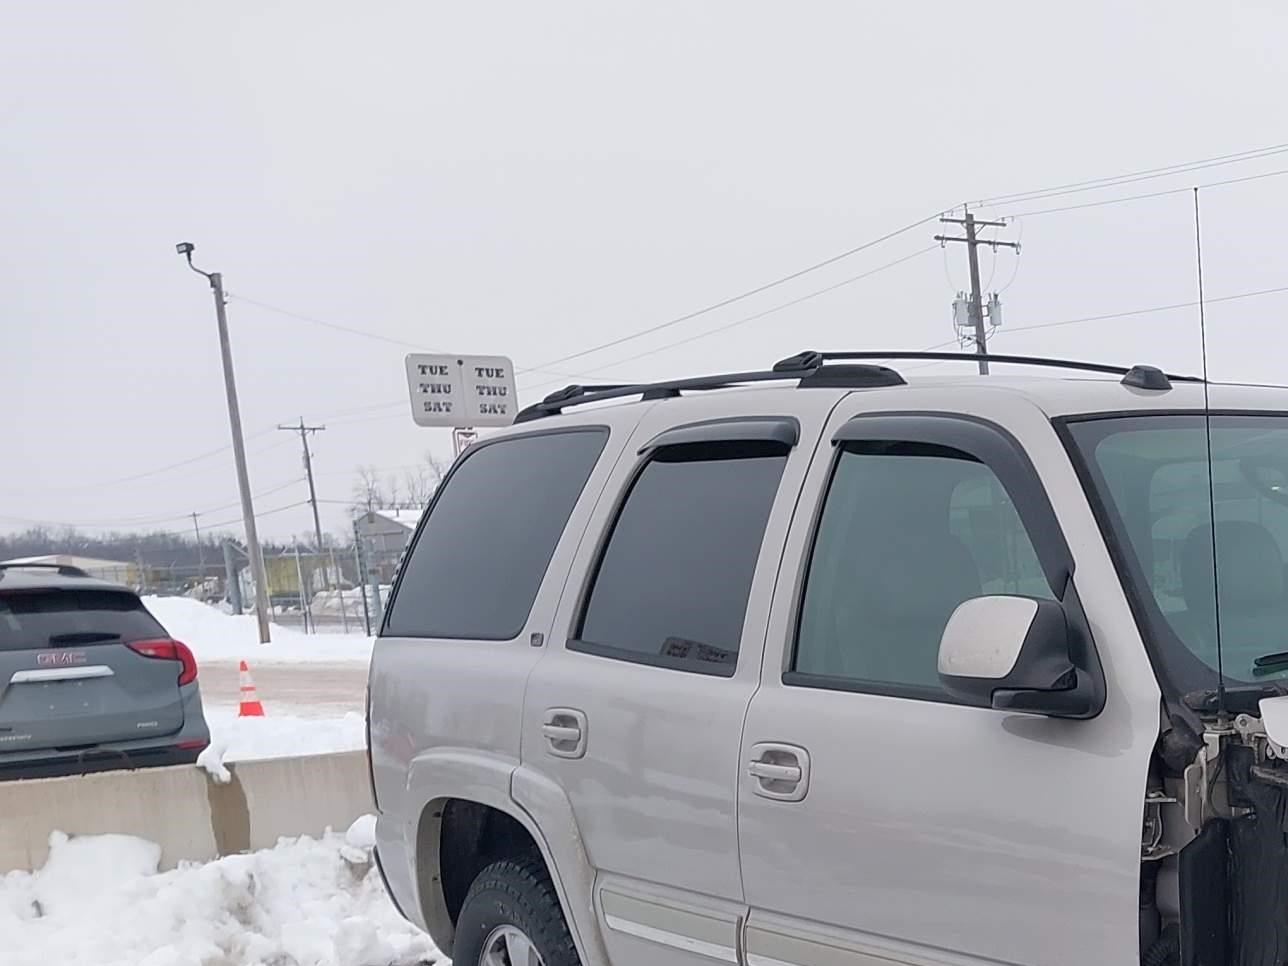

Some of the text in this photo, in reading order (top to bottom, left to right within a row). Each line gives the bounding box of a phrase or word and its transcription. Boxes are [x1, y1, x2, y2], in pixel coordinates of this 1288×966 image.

[418, 364, 448, 376] TUE
[475, 367, 504, 378] TUE
[420, 383, 451, 394] THU
[476, 385, 507, 396] THU
[424, 401, 452, 413] SAT
[480, 403, 506, 415] SAT
[36, 651, 87, 665] GMC
